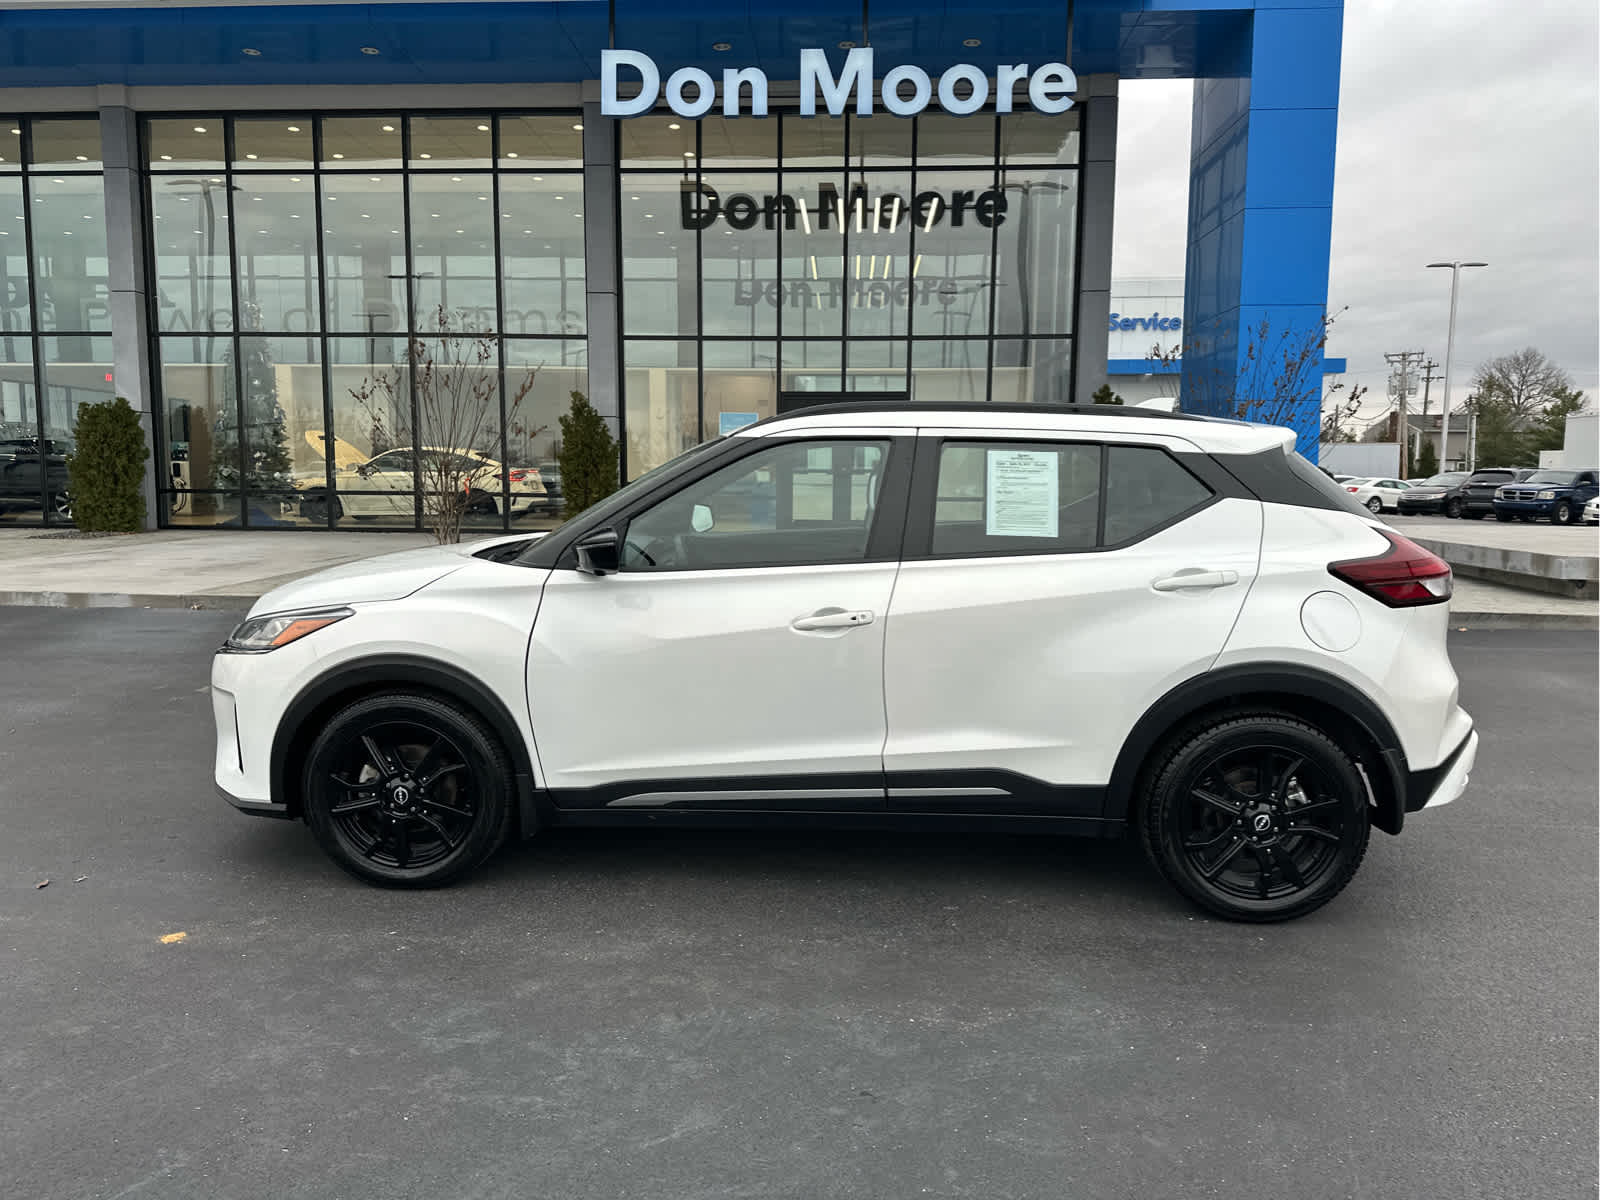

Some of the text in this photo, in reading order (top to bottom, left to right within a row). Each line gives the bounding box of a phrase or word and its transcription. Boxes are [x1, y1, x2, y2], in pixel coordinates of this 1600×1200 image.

[601, 47, 1078, 118] Don Moore
[680, 180, 796, 230] Don
[1108, 312, 1182, 331] Service
